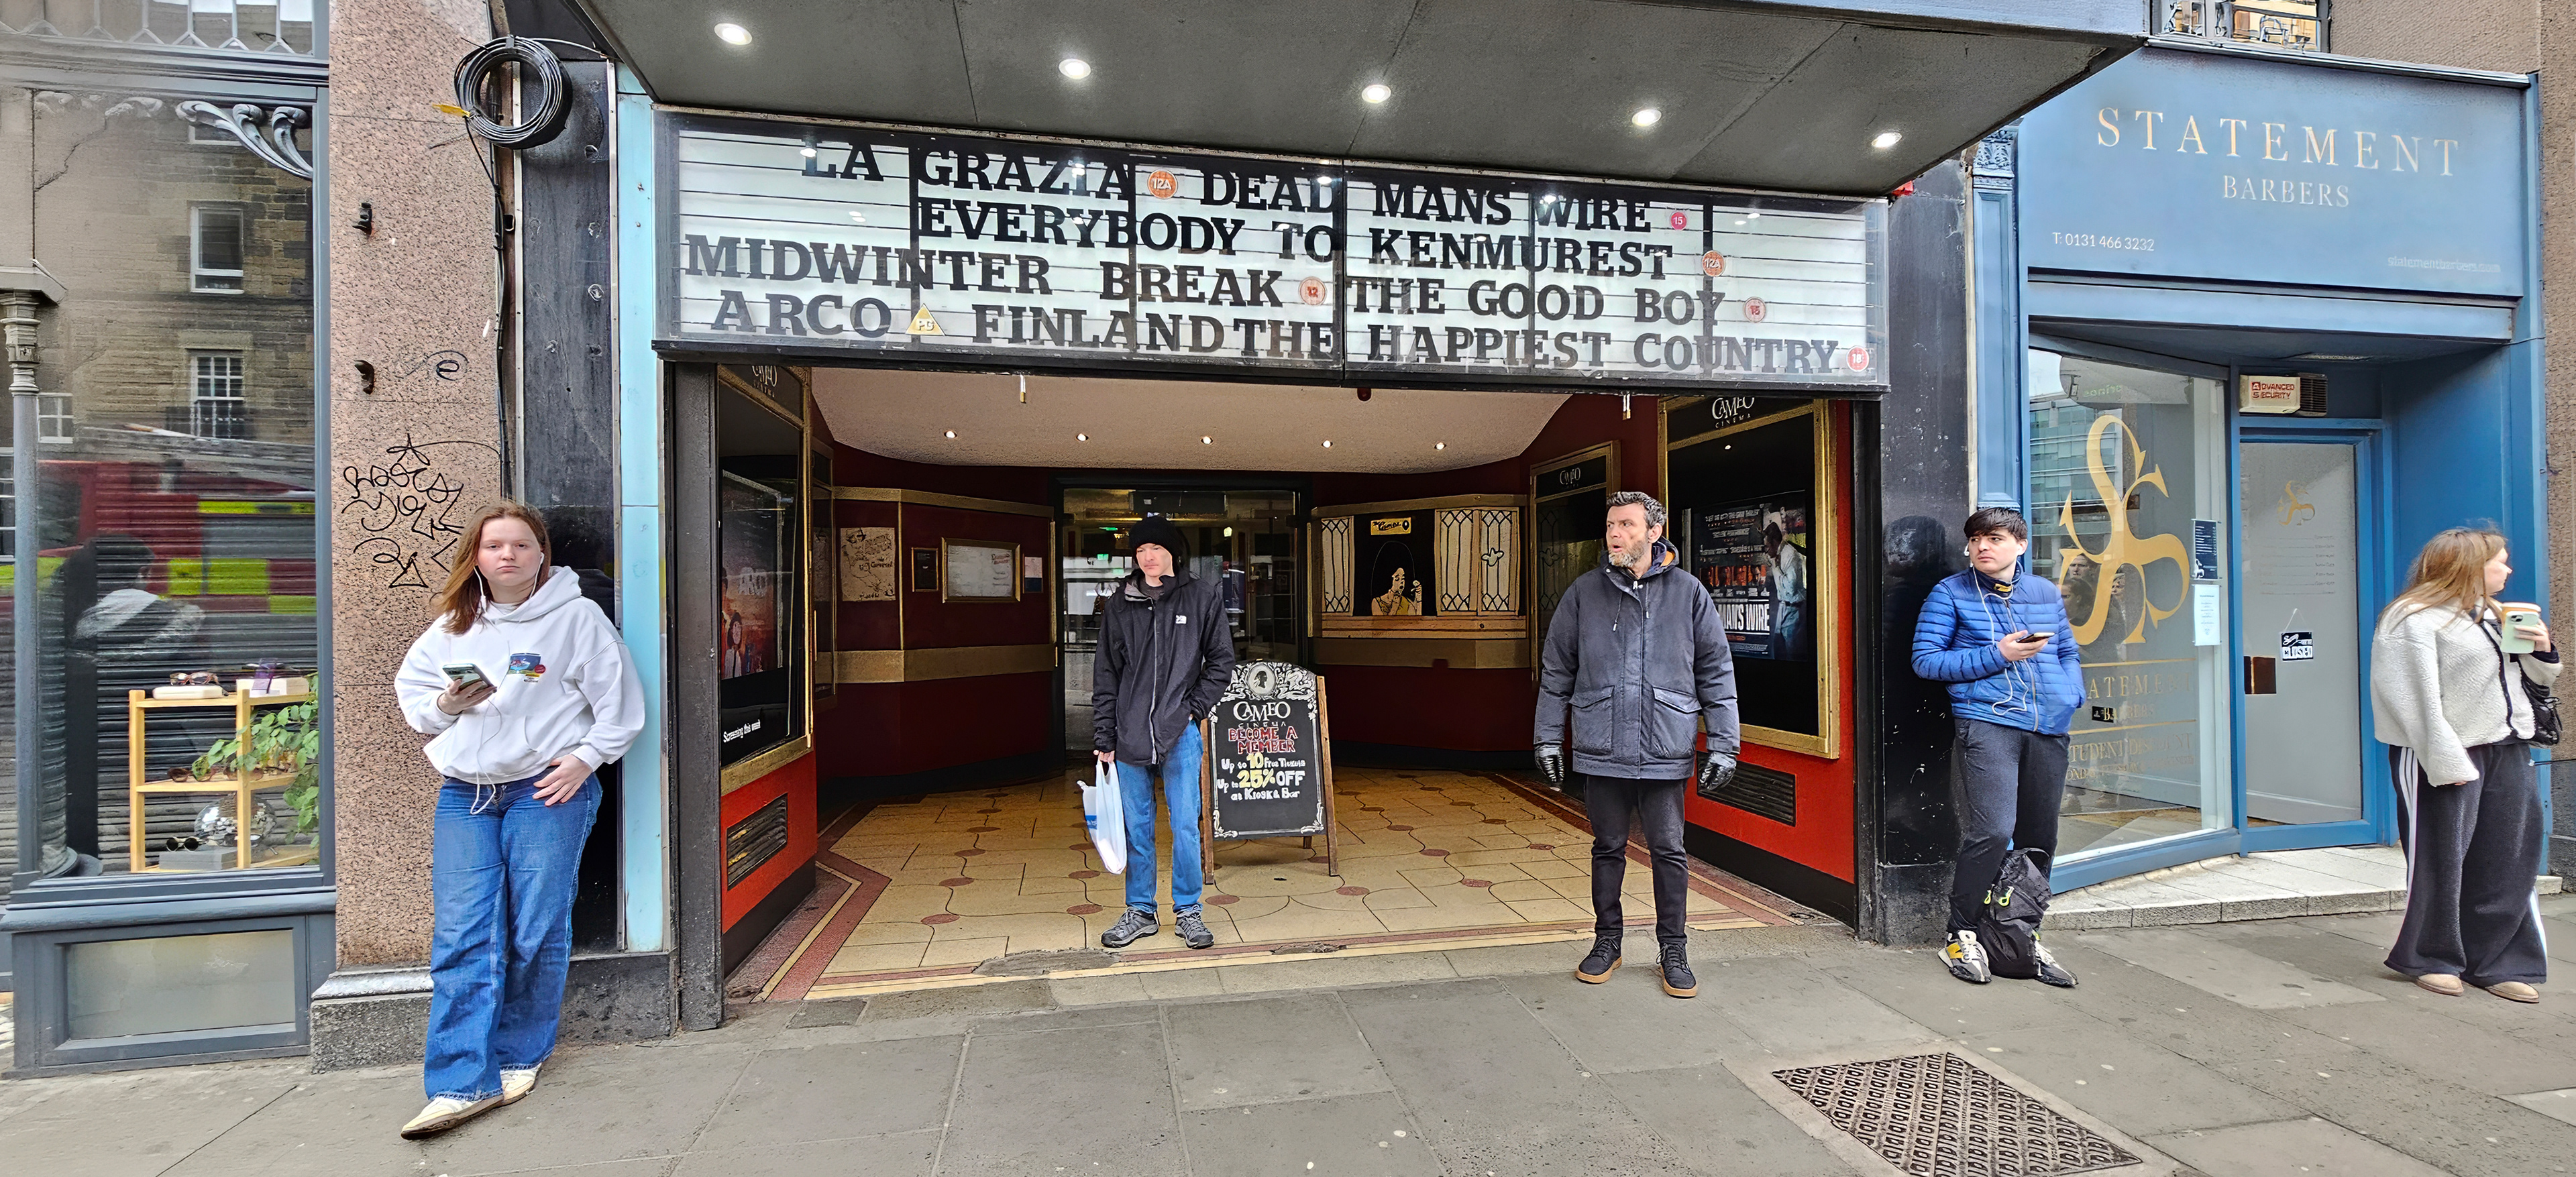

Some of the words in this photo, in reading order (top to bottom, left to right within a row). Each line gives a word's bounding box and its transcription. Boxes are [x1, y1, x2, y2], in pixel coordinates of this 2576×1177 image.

[2098, 107, 2459, 176] STATEMENT
[801, 139, 883, 182] LA
[918, 148, 1133, 199] GRAZIA
[1152, 176, 1172, 190] 12A
[1200, 170, 1335, 213] DEAD
[1373, 183, 1511, 225] MANS
[1534, 194, 1651, 233] WIRE
[1672, 216, 1683, 225] 15
[2222, 175, 2349, 208] BARBERS
[918, 199, 1245, 256] EVERYBODY
[1272, 221, 1340, 262] TO
[2052, 232, 2062, 244] T:
[2065, 233, 2095, 247] 0131
[2099, 236, 2122, 249] 466
[2125, 237, 2155, 251] 3232
[685, 233, 1053, 294] MIDWINTER
[1100, 260, 1283, 307] BREAK
[1345, 276, 1445, 315] THE
[1468, 280, 1604, 321] GOOD
[1634, 288, 1725, 325] BOY
[710, 289, 892, 338] ARCO
[916, 319, 936, 331] PG
[972, 304, 1225, 352] FINLAND
[1233, 317, 1334, 359] THE
[1367, 324, 1611, 368] HAPPIEST
[1633, 333, 1839, 374] COUNTRY
[1851, 353, 1862, 363] 18
[2251, 382, 2295, 391] ADVANCED
[2252, 392, 2292, 400] SECURITY
[1746, 604, 1770, 631] WIRE
[2087, 673, 2192, 699] ATEMENT
[1233, 701, 1291, 722] CAMEO
[1228, 726, 1280, 742] BECOME
[1285, 726, 1299, 740] A
[1238, 738, 1296, 754] MEMBER
[1221, 758, 1235, 774] Up
[1237, 760, 1247, 769] to
[1246, 751, 1264, 769] 10
[2069, 740, 2124, 763] TUDENT
[1217, 778, 1230, 794] Up
[1237, 768, 1275, 789] 25%
[1275, 770, 1305, 787] OFF
